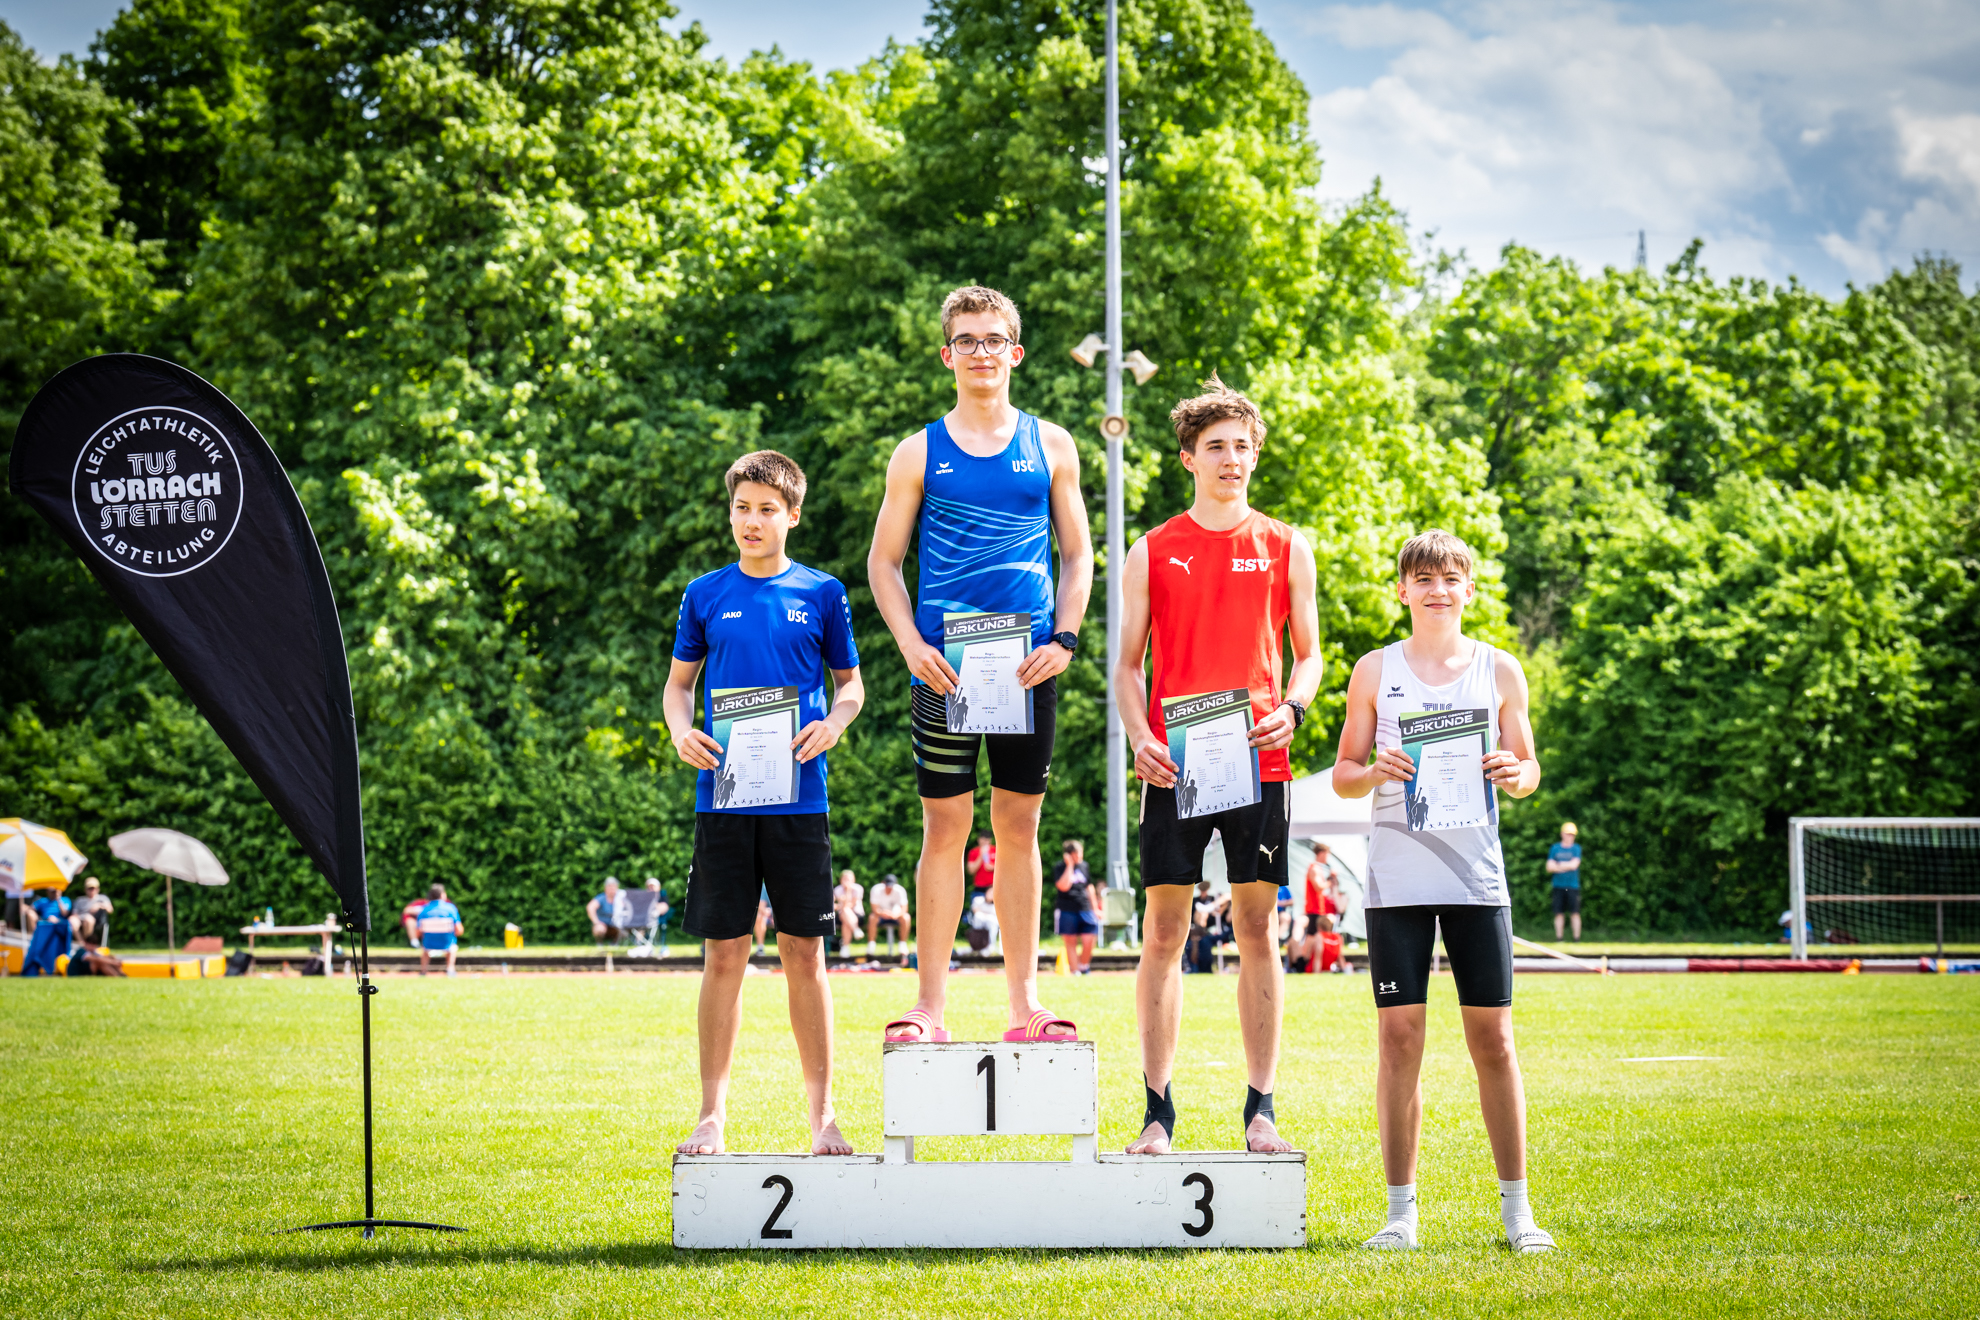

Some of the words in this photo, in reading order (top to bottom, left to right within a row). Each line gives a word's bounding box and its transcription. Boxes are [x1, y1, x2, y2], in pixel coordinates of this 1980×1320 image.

[85, 416, 223, 475] LEICHTATHLETIK
[127, 449, 176, 476] TUS
[1012, 460, 1035, 473] USC
[90, 472, 222, 504] LÖRRACH
[100, 498, 217, 530] STETTEN
[102, 527, 216, 565] ABTEILUNG
[1231, 558, 1272, 572] ESV
[721, 610, 742, 620] JAKO
[787, 609, 808, 624] USC
[946, 618, 1015, 635] URKUNDE
[714, 691, 783, 712] URKUNDE
[1165, 694, 1235, 720] URKUNDE
[1403, 714, 1473, 735] URKUNDE
[819, 912, 835, 920] JAK
[976, 1054, 996, 1131] 1
[760, 1174, 794, 1239] 2
[1181, 1172, 1214, 1238] 3
